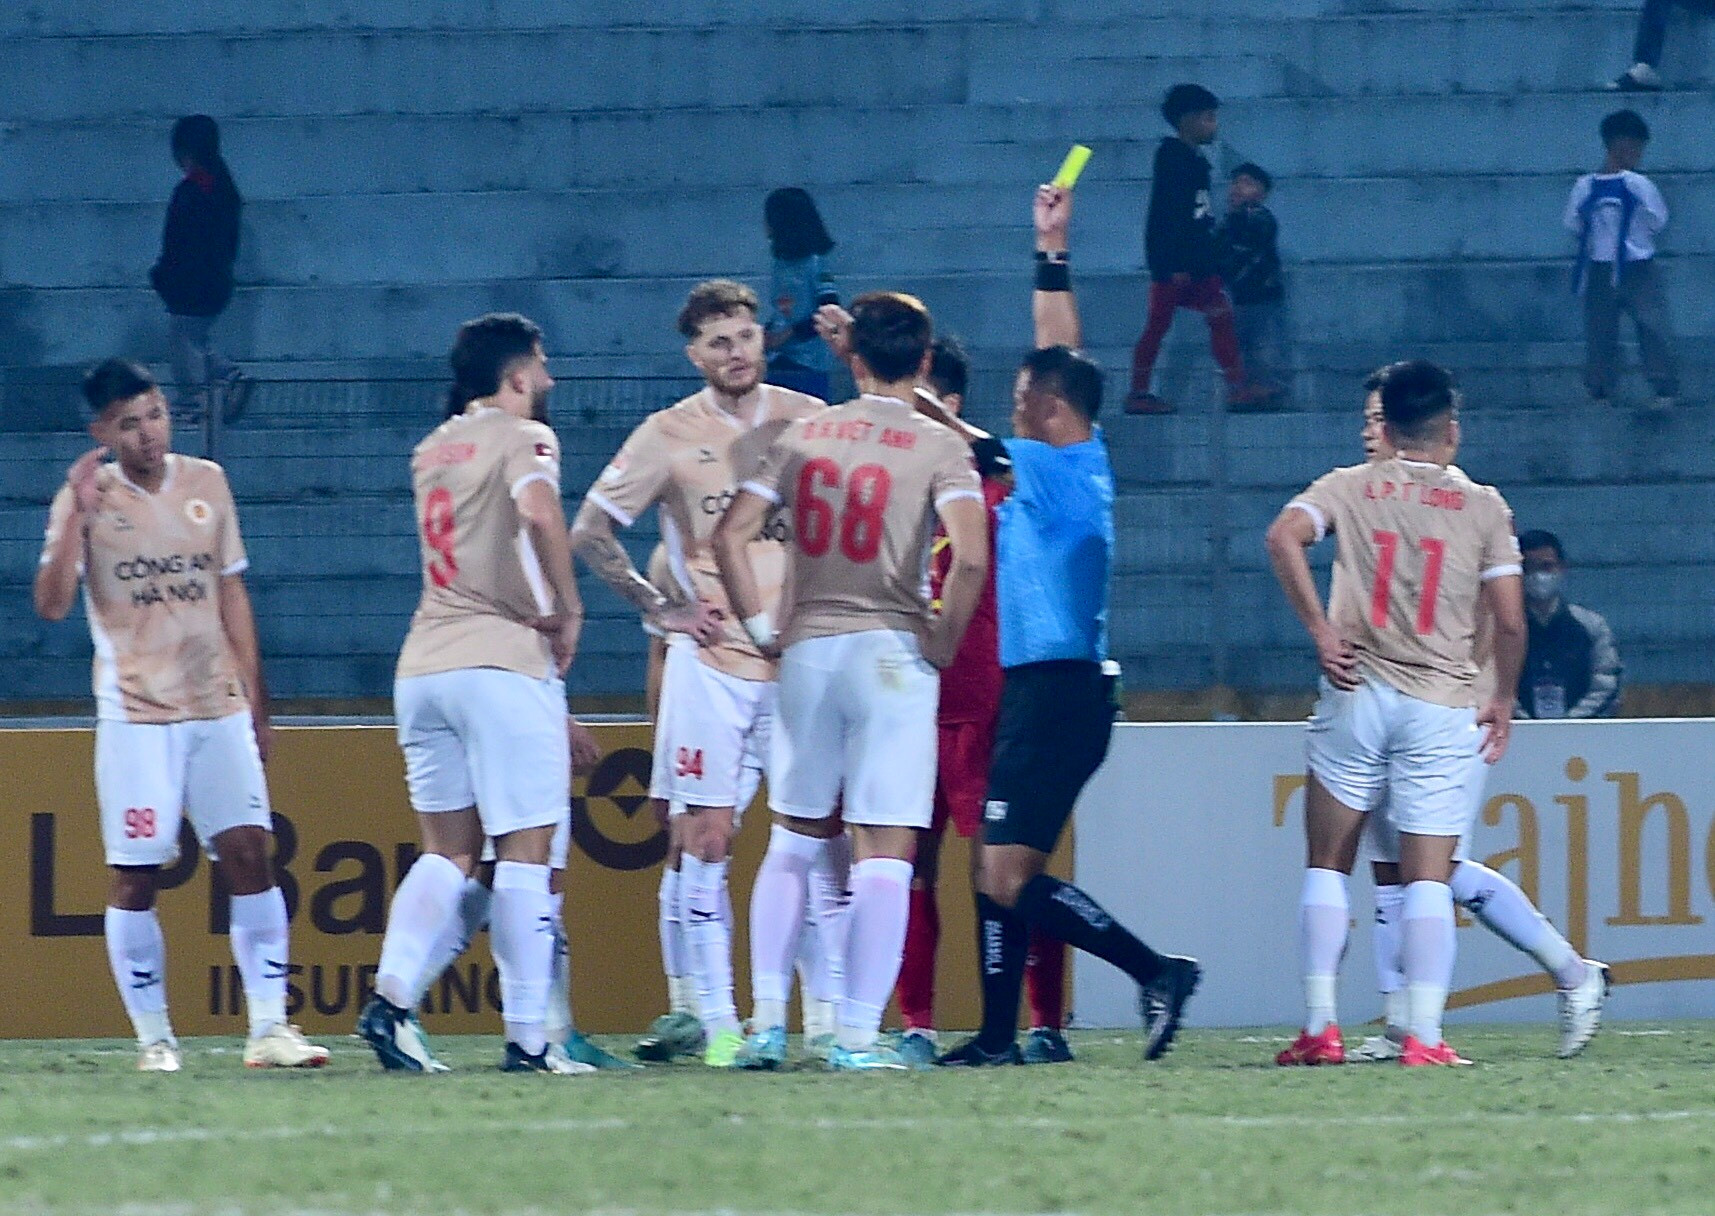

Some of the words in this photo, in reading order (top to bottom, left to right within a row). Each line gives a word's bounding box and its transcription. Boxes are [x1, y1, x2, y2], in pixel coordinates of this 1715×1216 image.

[424, 486, 459, 588] 9
[796, 456, 892, 564] 68
[115, 555, 183, 580] CÔNG
[1371, 529, 1445, 636] 11
[676, 746, 703, 780] 94
[124, 807, 156, 839] 98
